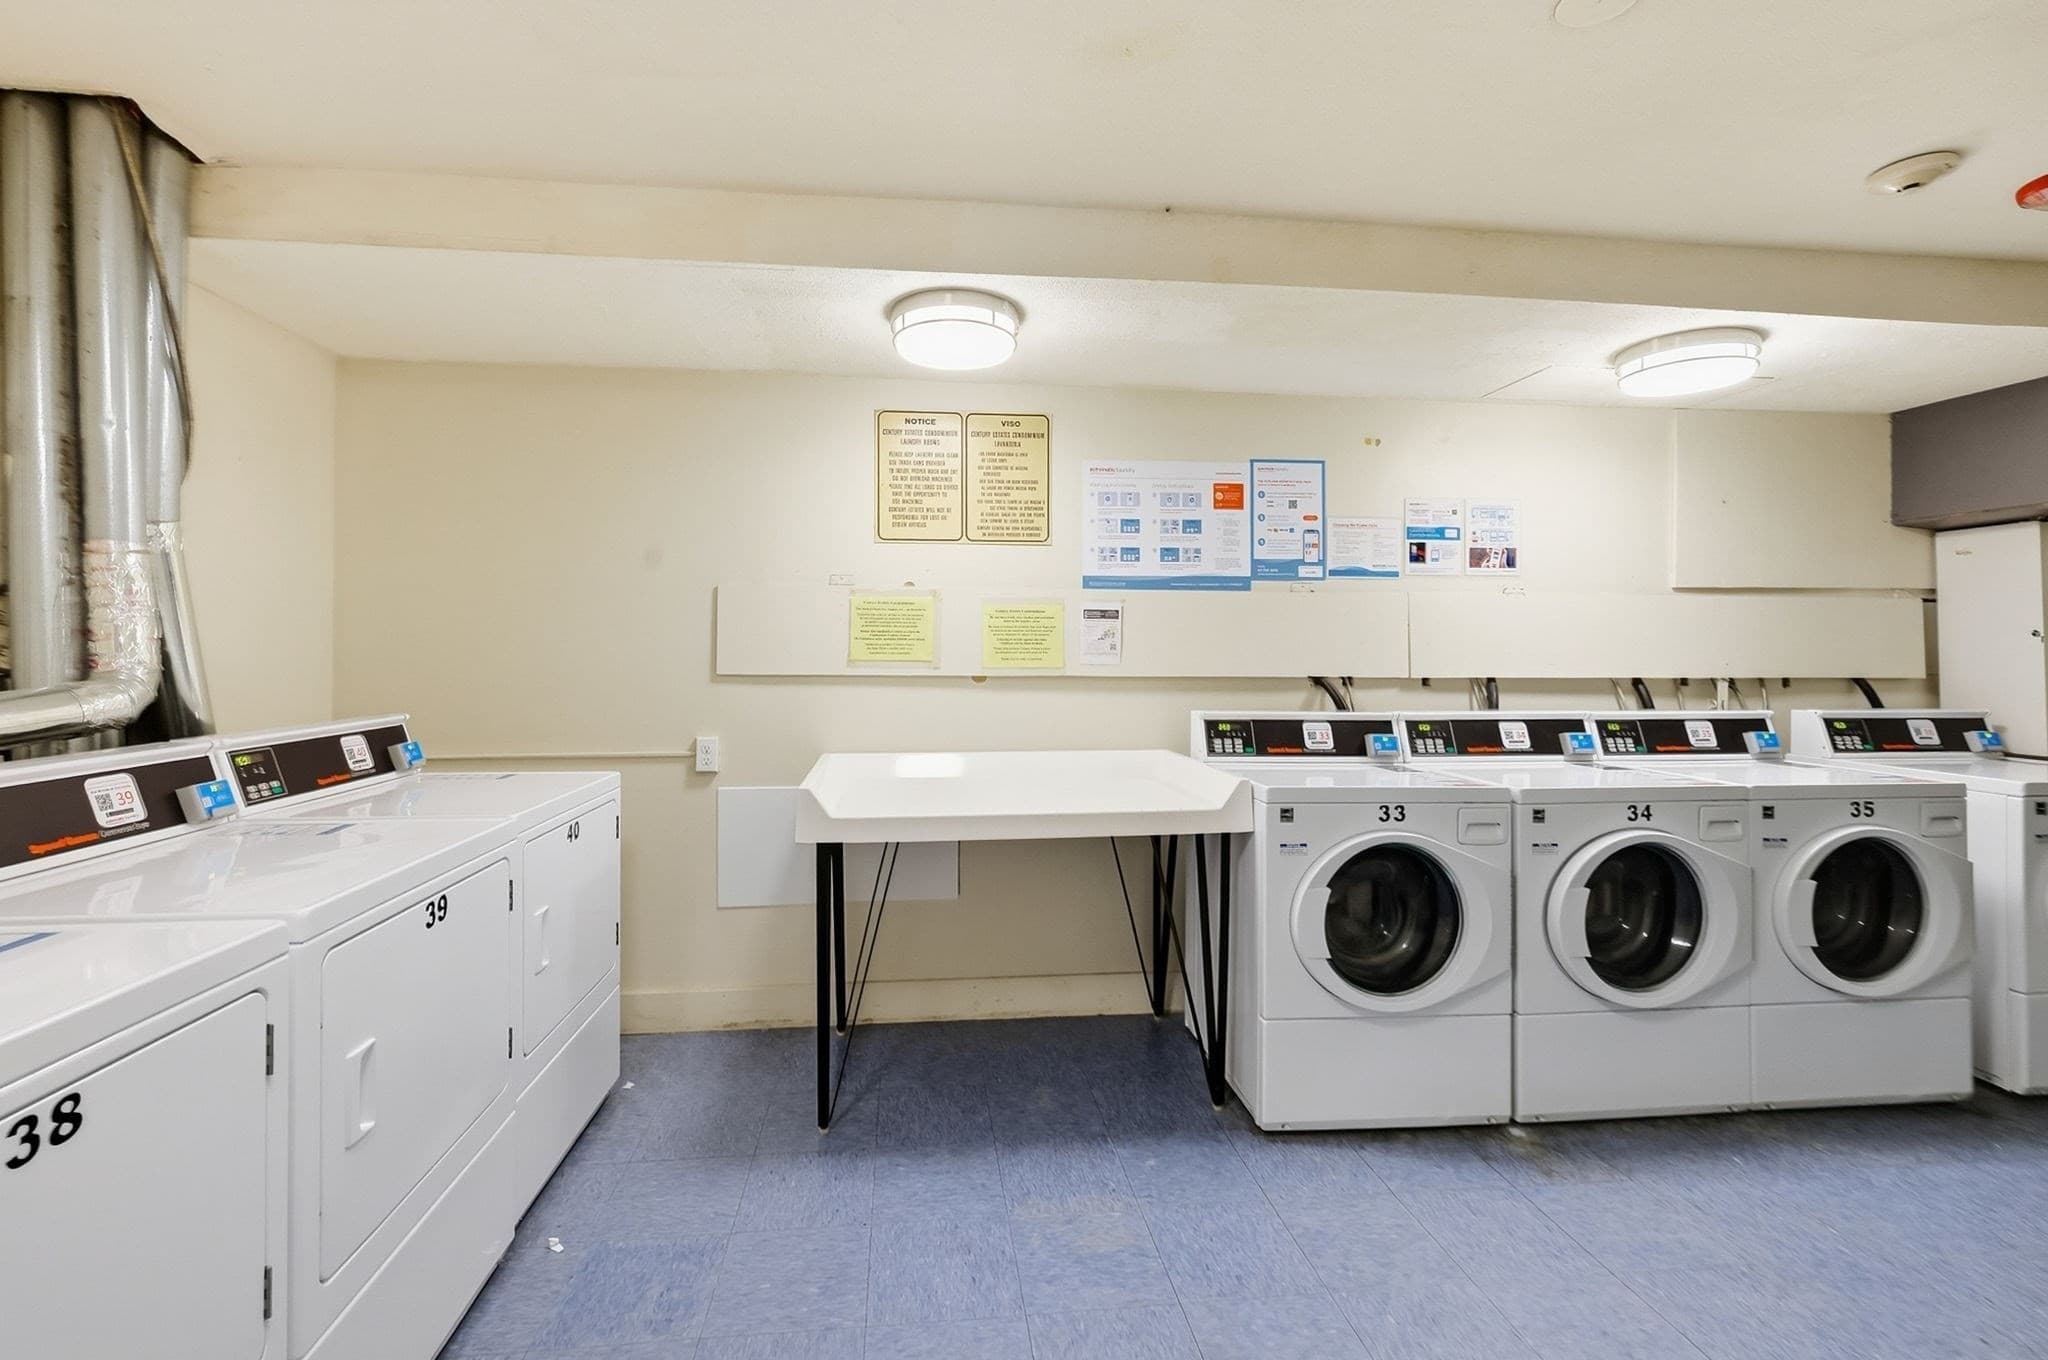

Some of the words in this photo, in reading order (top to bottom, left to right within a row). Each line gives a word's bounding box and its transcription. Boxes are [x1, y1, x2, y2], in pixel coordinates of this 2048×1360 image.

[1318, 732, 1329, 740] 33
[116, 791, 134, 806] 39
[1378, 805, 1406, 822] 33
[1626, 804, 1652, 822] 34
[1850, 801, 1875, 818] 35
[566, 821, 580, 843] 40
[425, 894, 448, 929] 39
[5, 1092, 83, 1170] 38
